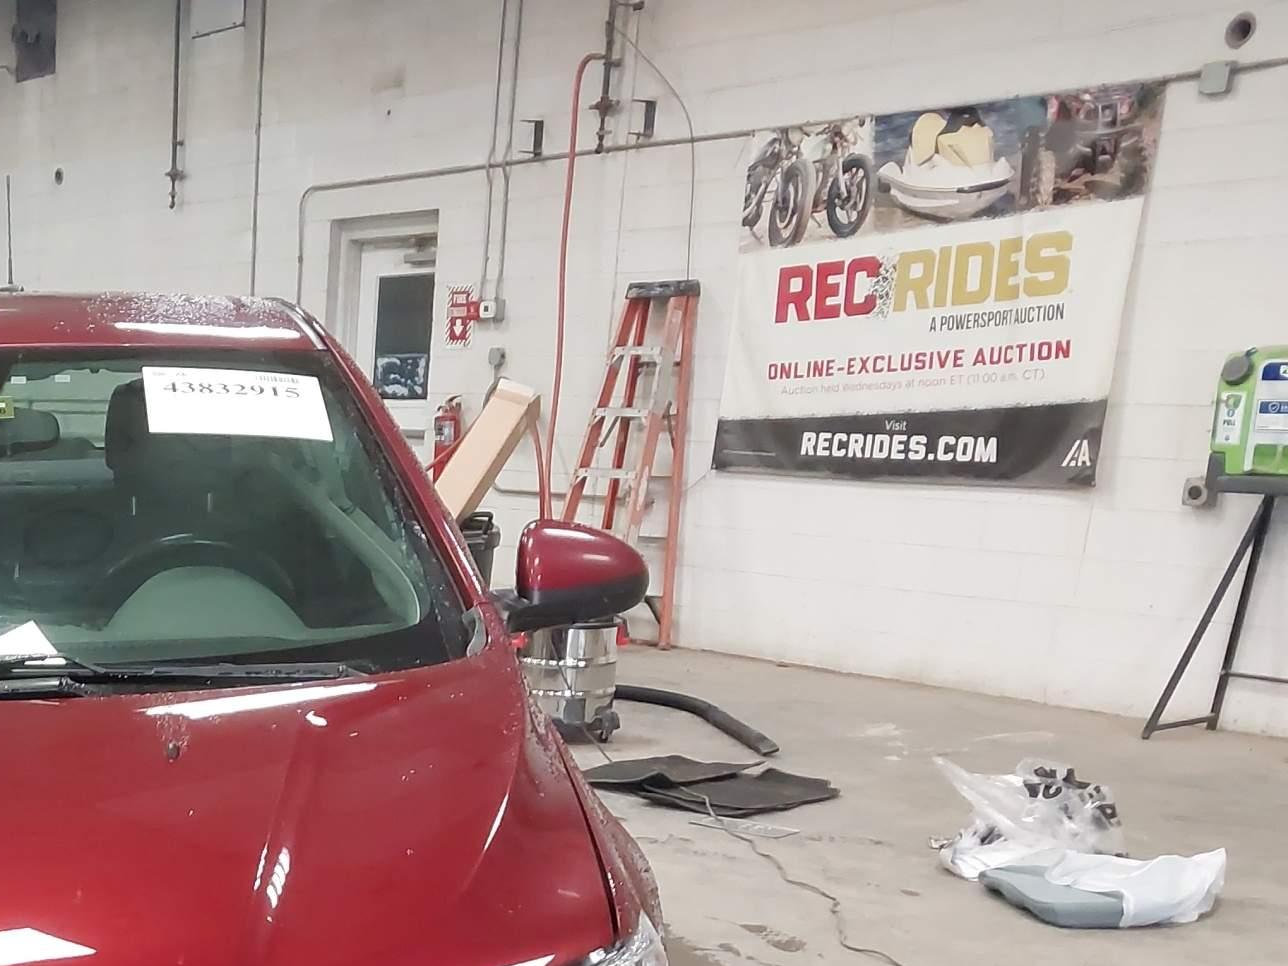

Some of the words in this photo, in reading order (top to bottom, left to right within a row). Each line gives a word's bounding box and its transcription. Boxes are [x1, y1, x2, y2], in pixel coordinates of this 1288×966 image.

[775, 256, 880, 323] REC
[892, 230, 1074, 312] RIDES
[929, 316, 937, 332] A
[768, 348, 965, 380] ONLINE-EXCLUSIVE
[972, 339, 1072, 367] AUCTION
[967, 371, 998, 386] (1100
[1022, 367, 1047, 383] CT)
[163, 381, 301, 399] 43832915
[884, 419, 908, 432] Visit
[800, 431, 998, 463] RECRIDES.COM
